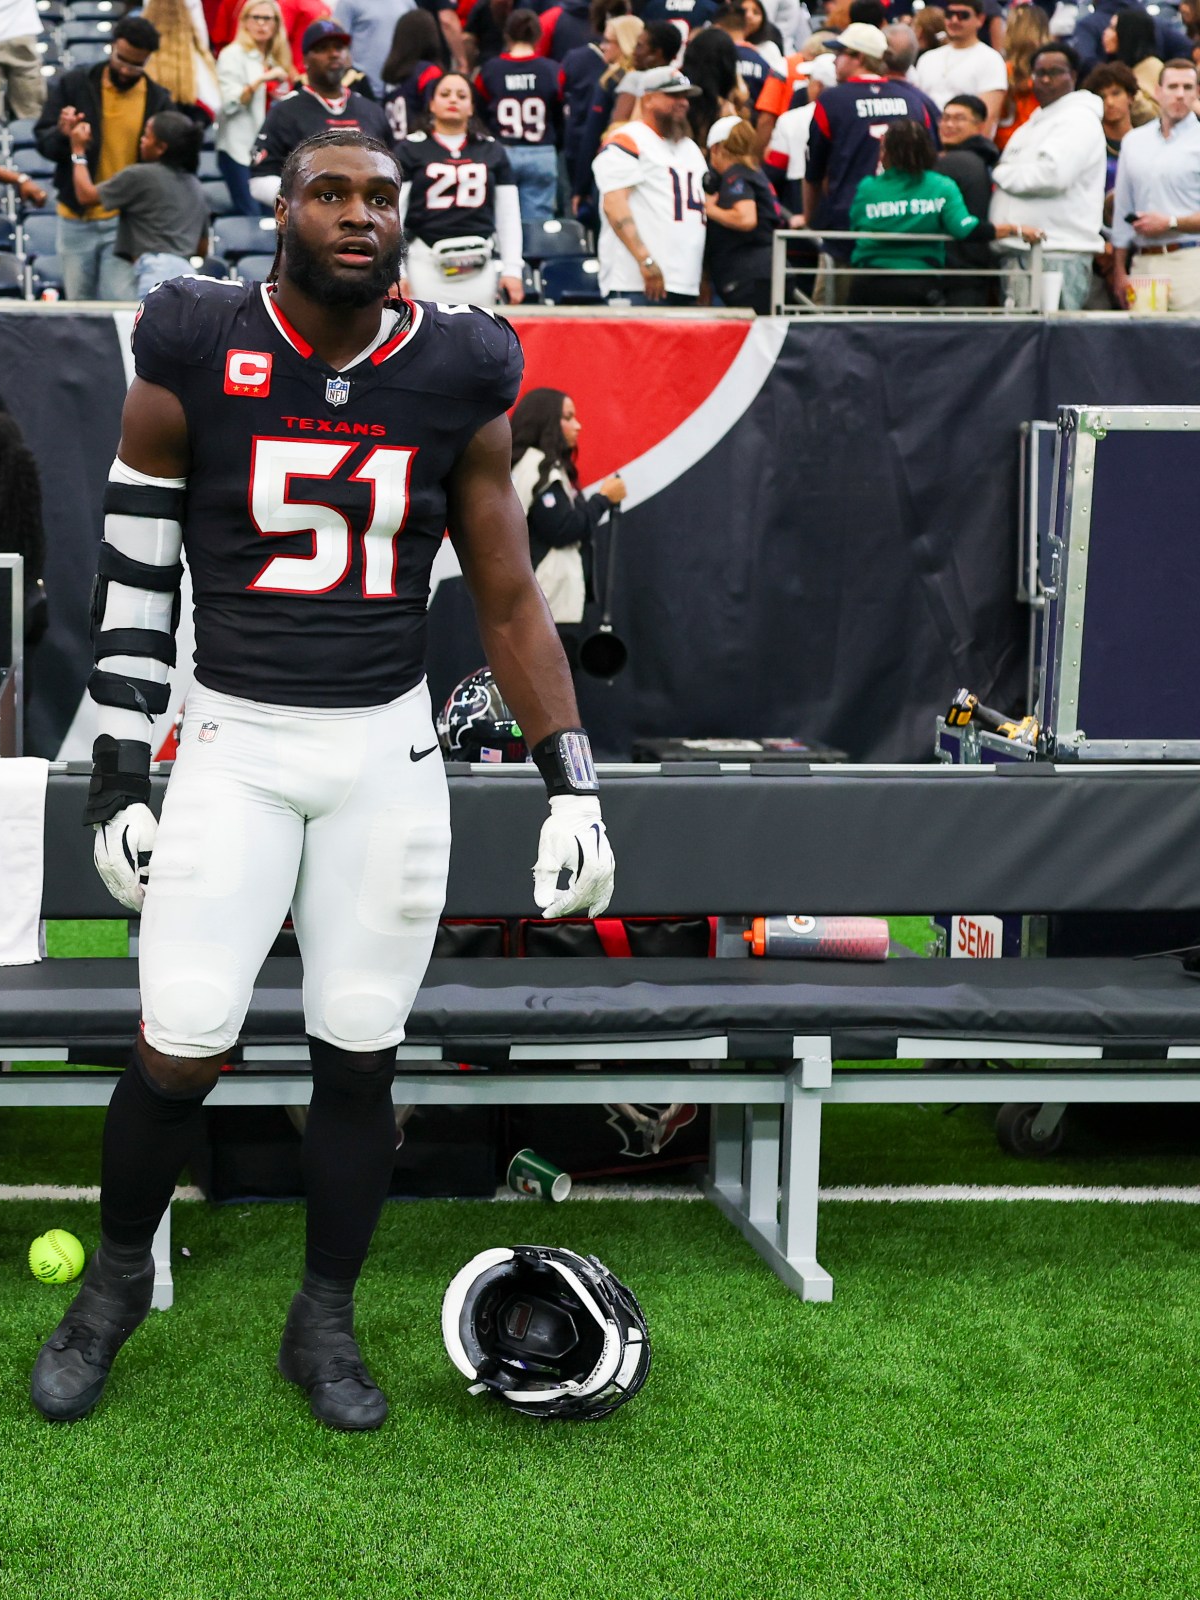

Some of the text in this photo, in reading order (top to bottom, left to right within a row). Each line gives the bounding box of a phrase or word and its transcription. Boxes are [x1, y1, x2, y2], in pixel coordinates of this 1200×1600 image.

[505, 73, 537, 91] WATT
[497, 97, 546, 142] 99
[855, 97, 908, 118] STROUD
[425, 162, 487, 210] 28
[668, 166, 708, 225] 14
[865, 200, 908, 219] EVENT
[228, 352, 268, 385] C
[329, 389, 346, 402] NFL
[281, 416, 387, 437] TEXANS
[245, 435, 420, 599] 51
[957, 915, 995, 959] SEMI
